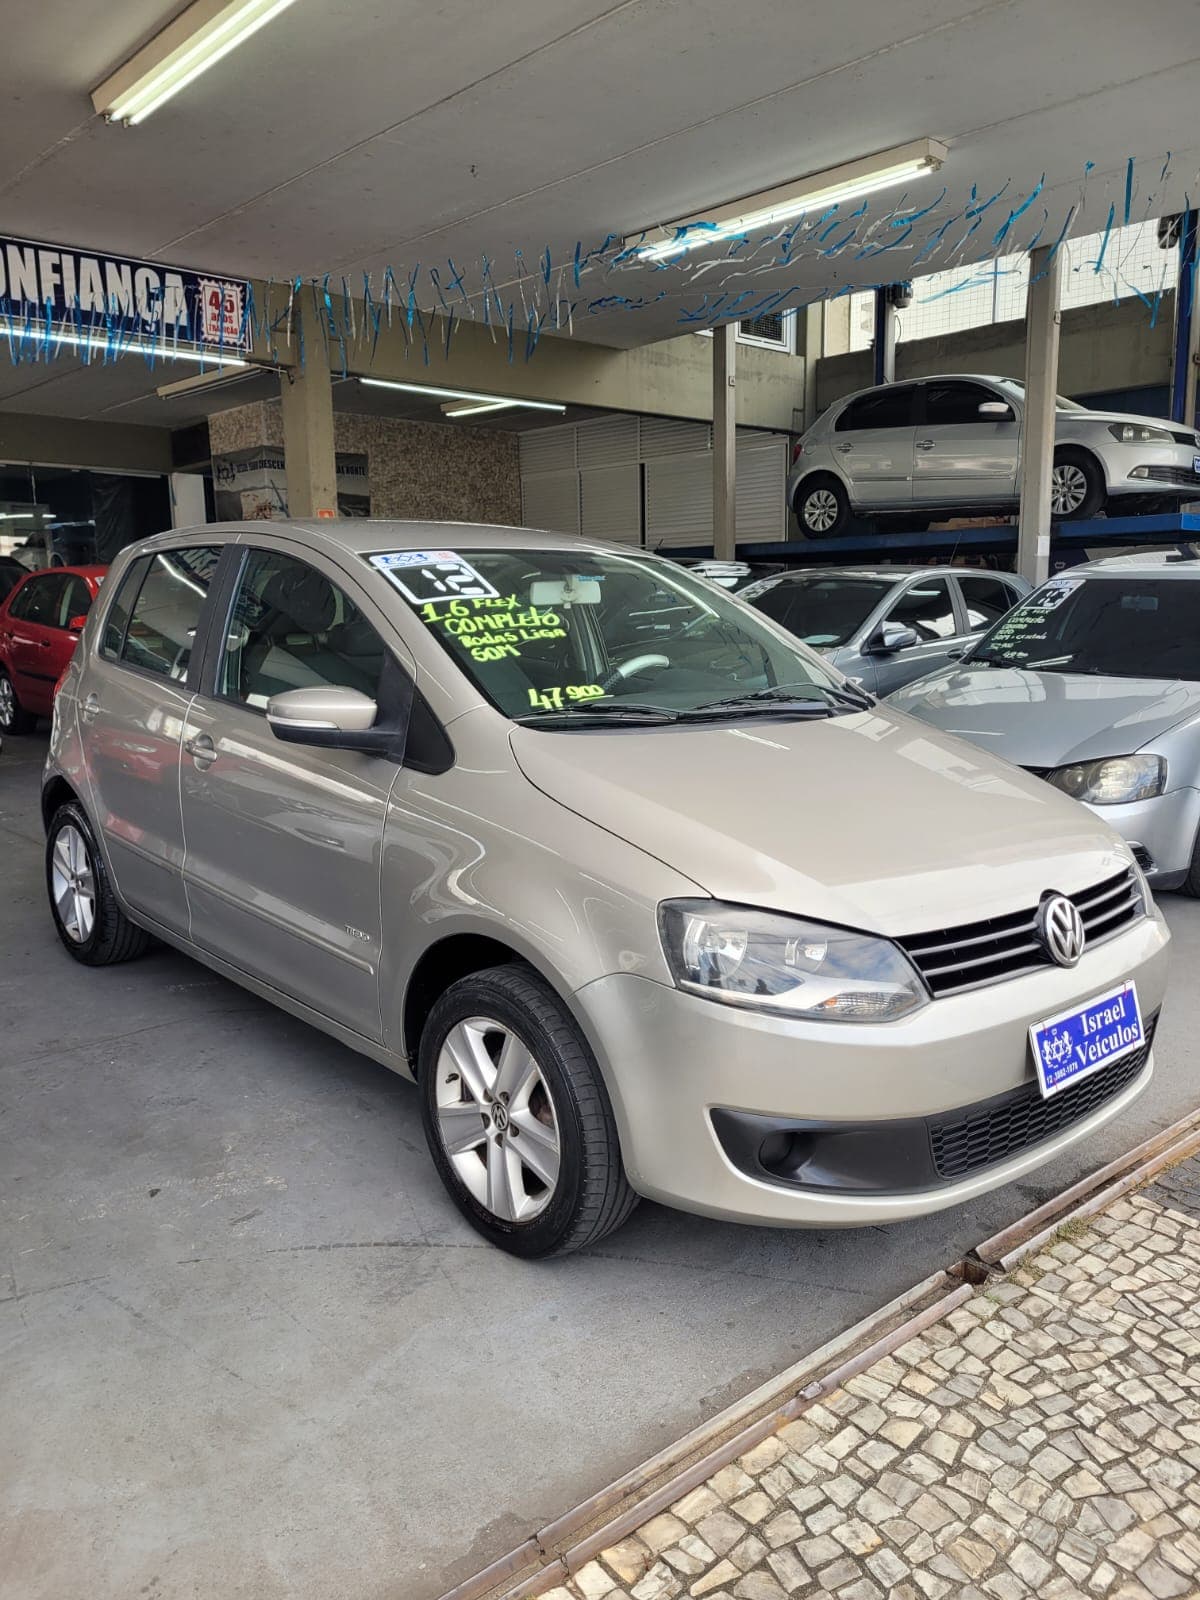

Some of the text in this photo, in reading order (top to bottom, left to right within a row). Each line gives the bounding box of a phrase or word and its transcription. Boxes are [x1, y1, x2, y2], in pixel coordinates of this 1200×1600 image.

[0, 244, 189, 333] NFIANÇA
[209, 291, 235, 313] 45
[421, 563, 485, 595] 12
[421, 594, 522, 622] 1.6 FLEX
[471, 644, 521, 662] SOM
[1080, 996, 1126, 1036] Israel
[1075, 1021, 1139, 1065] Veículos
